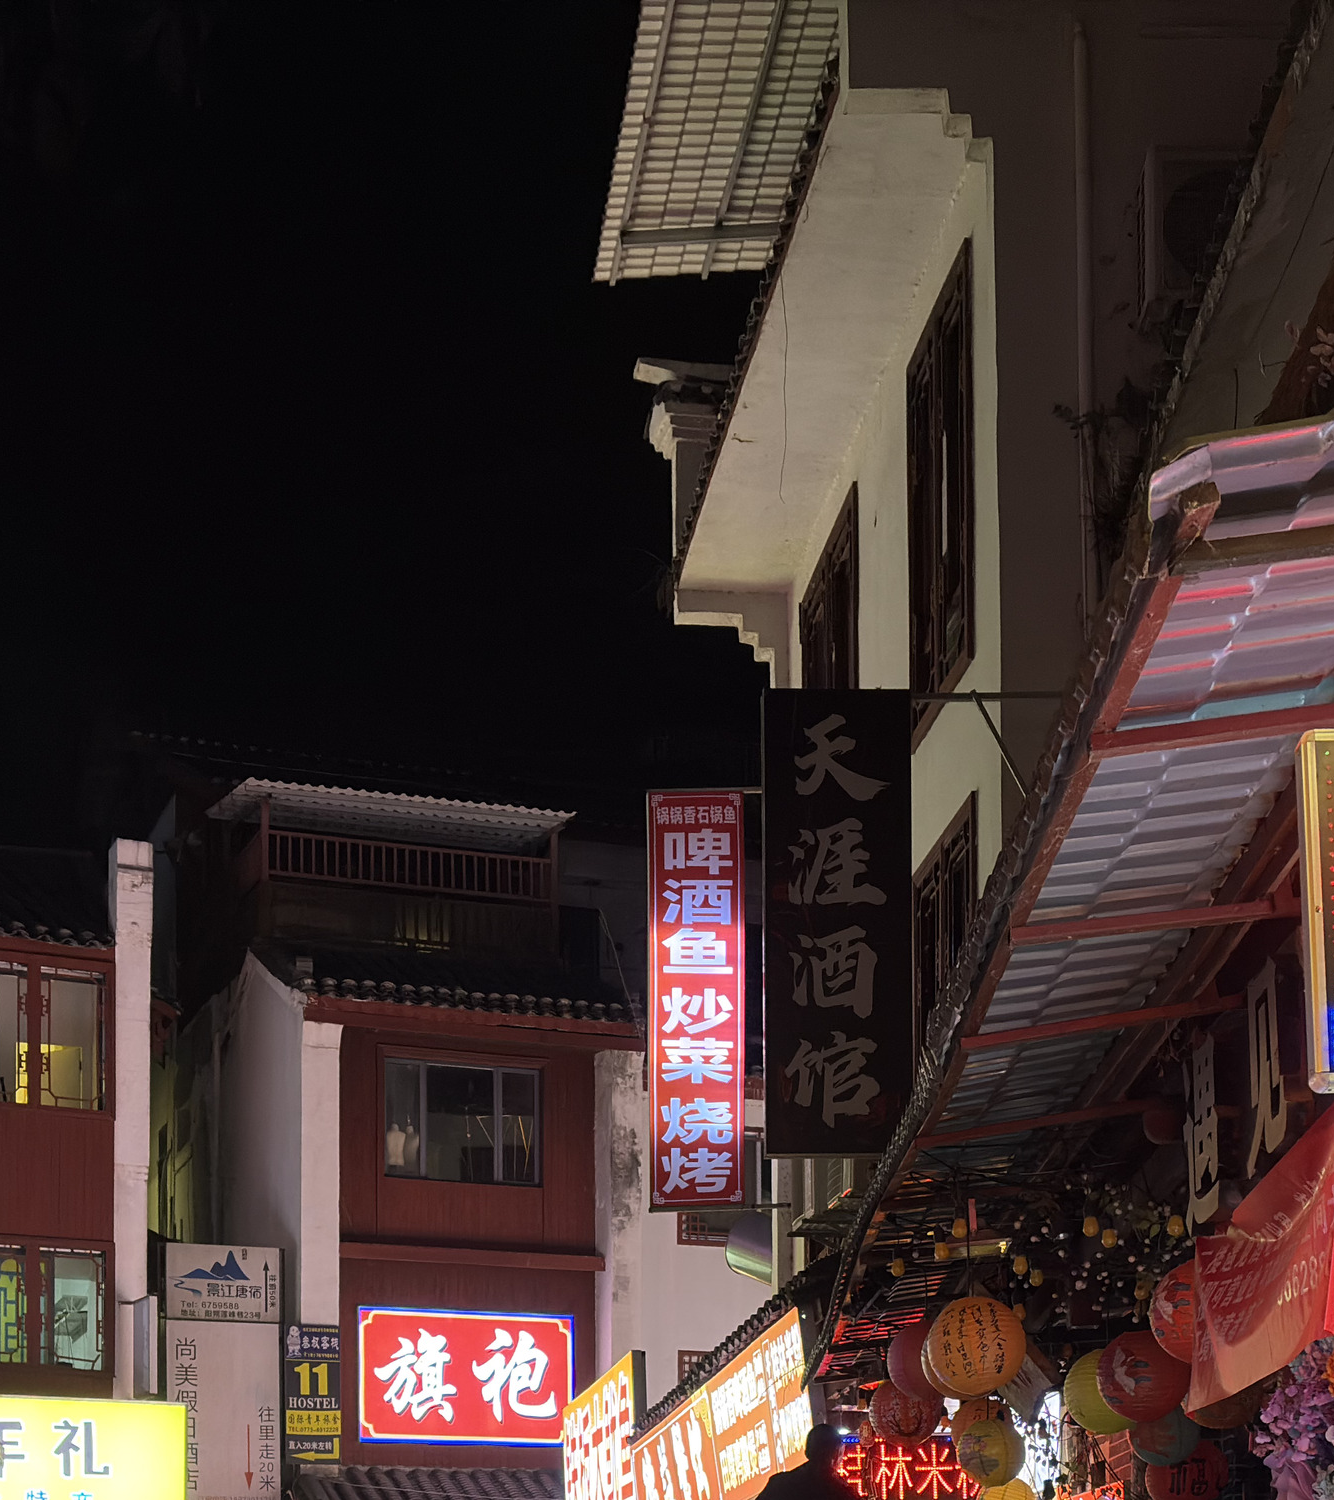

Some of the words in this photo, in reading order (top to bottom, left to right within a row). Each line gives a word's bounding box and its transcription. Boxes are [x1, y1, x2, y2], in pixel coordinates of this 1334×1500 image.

[655, 805, 737, 825] 锅锅香石锅鱼
[662, 828, 734, 975] 啤酒鱼
[784, 713, 891, 1129] 天涯酒馆
[661, 987, 735, 1085] 炒菜
[661, 1097, 734, 1195] 烧烤
[289, 1397, 339, 1410] HOSTEL
[293, 1362, 329, 1396] 11
[373, 1328, 558, 1424] 旗袍
[258, 1406, 276, 1492] 往里走20米
